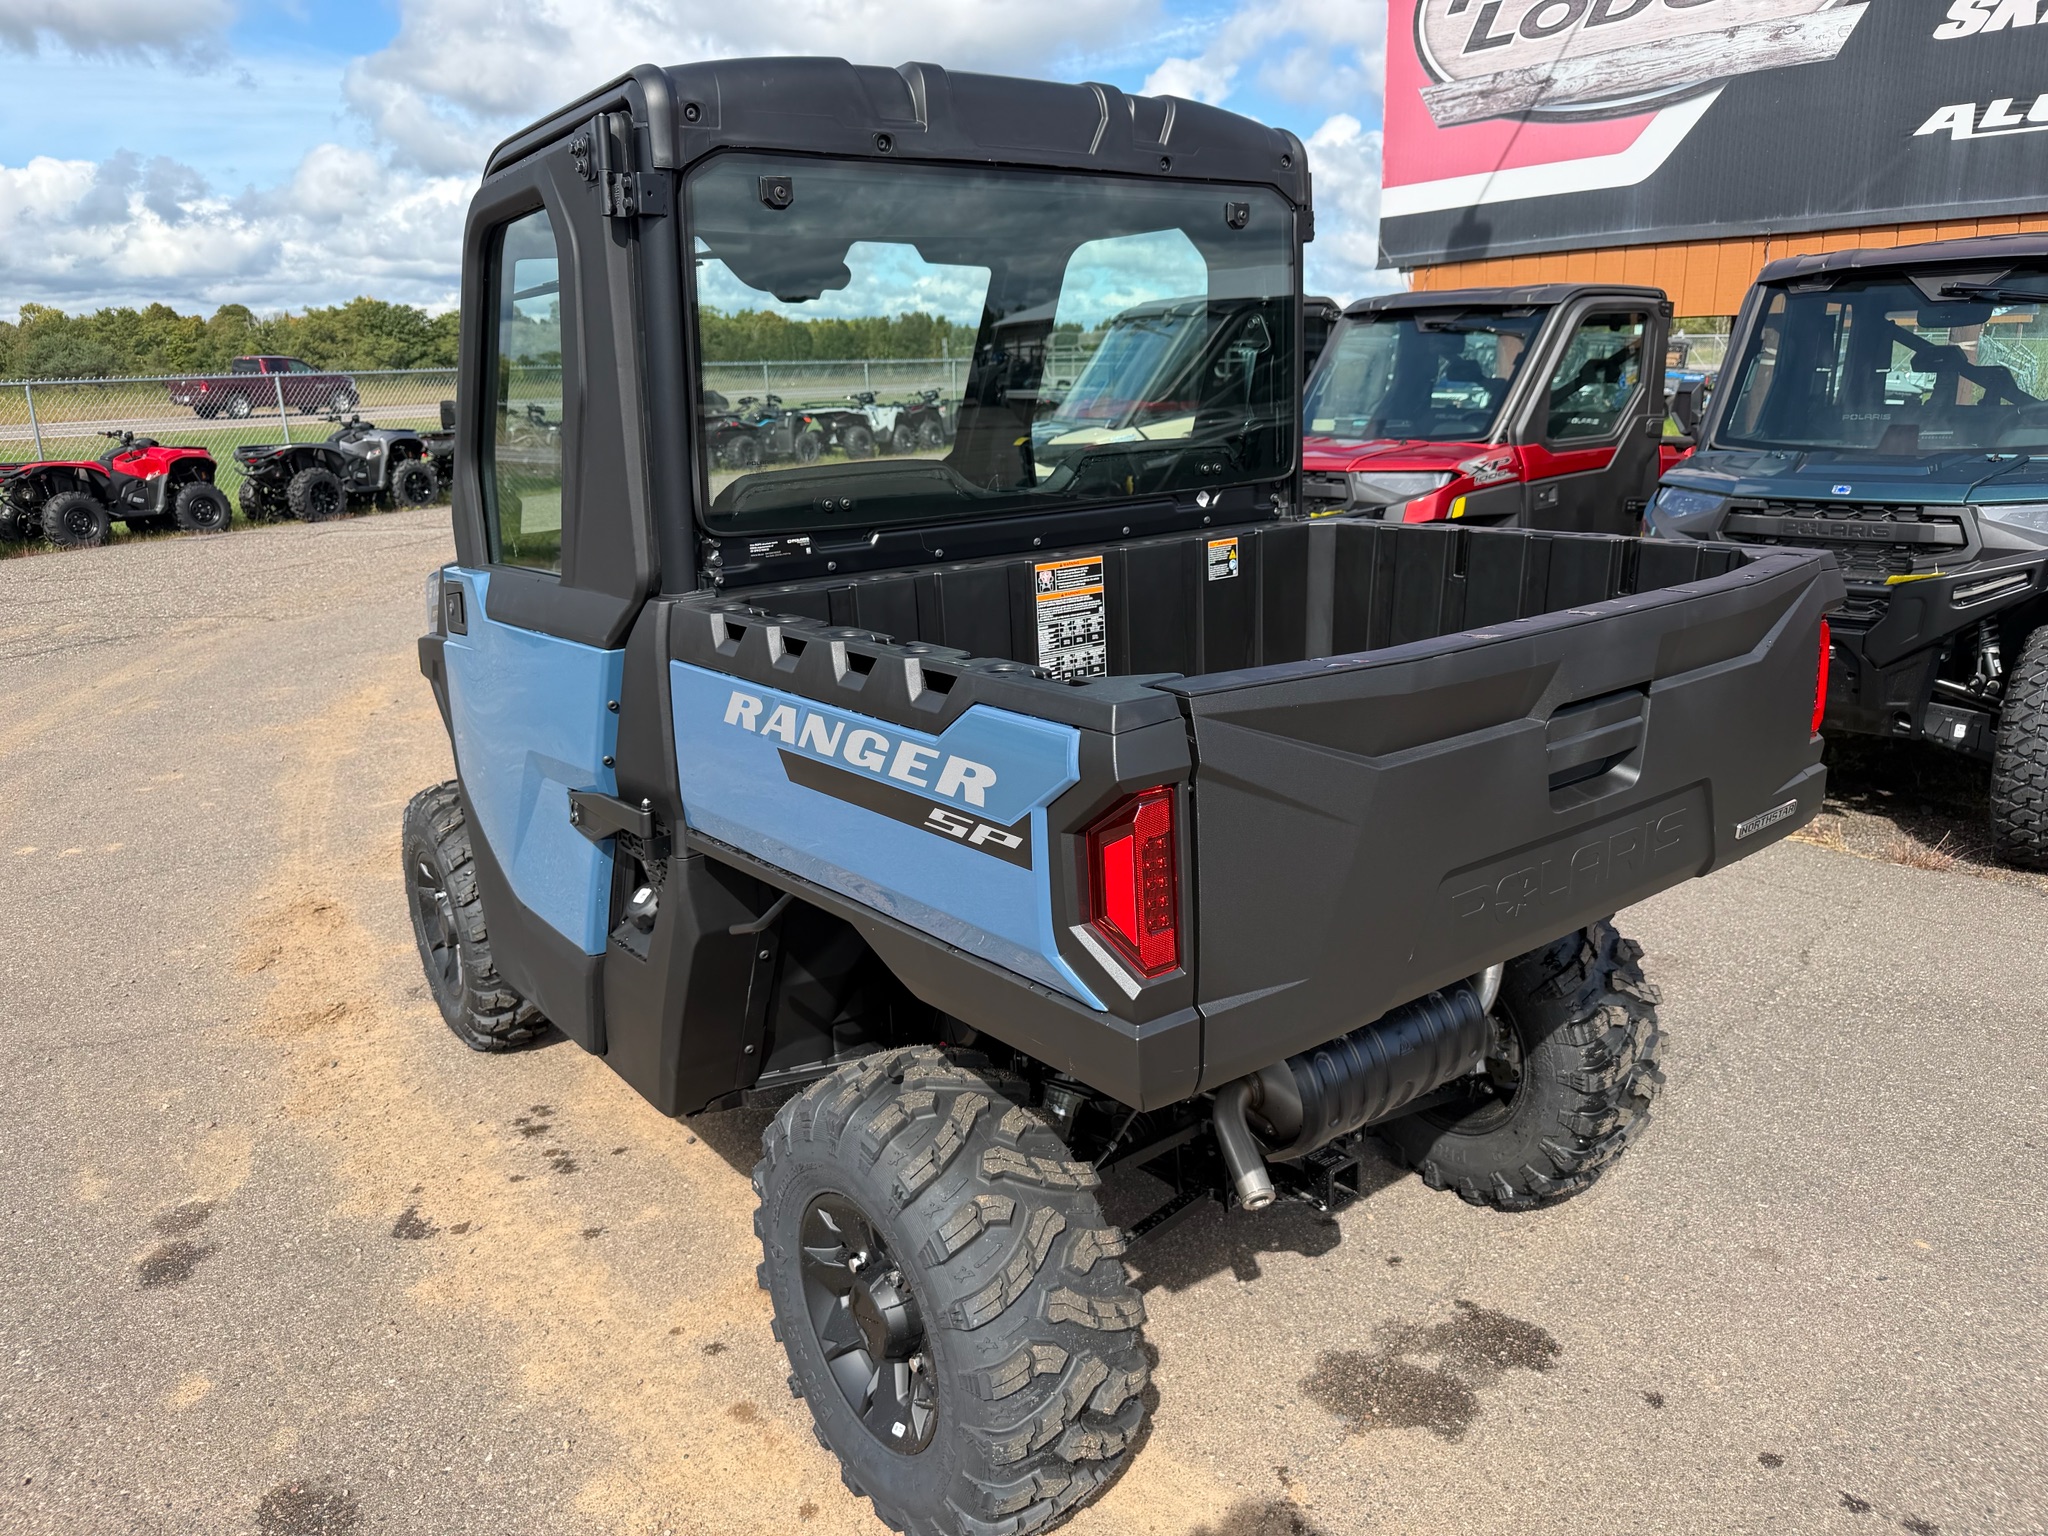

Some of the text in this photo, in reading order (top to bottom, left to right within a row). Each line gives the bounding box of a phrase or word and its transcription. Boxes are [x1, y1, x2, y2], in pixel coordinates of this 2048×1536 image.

[1463, 0, 1716, 54] LOD
[1932, 0, 2048, 40] SK
[1842, 413, 1891, 421] POLARIS
[1471, 457, 1510, 476] XP
[1475, 470, 1507, 483] 1000
[1782, 521, 1890, 539] POLARIS
[724, 691, 997, 808] RANGER
[923, 807, 1023, 849] SP
[1739, 803, 1796, 837] NORTHSTAR
[1452, 807, 1687, 924] POLARIS
